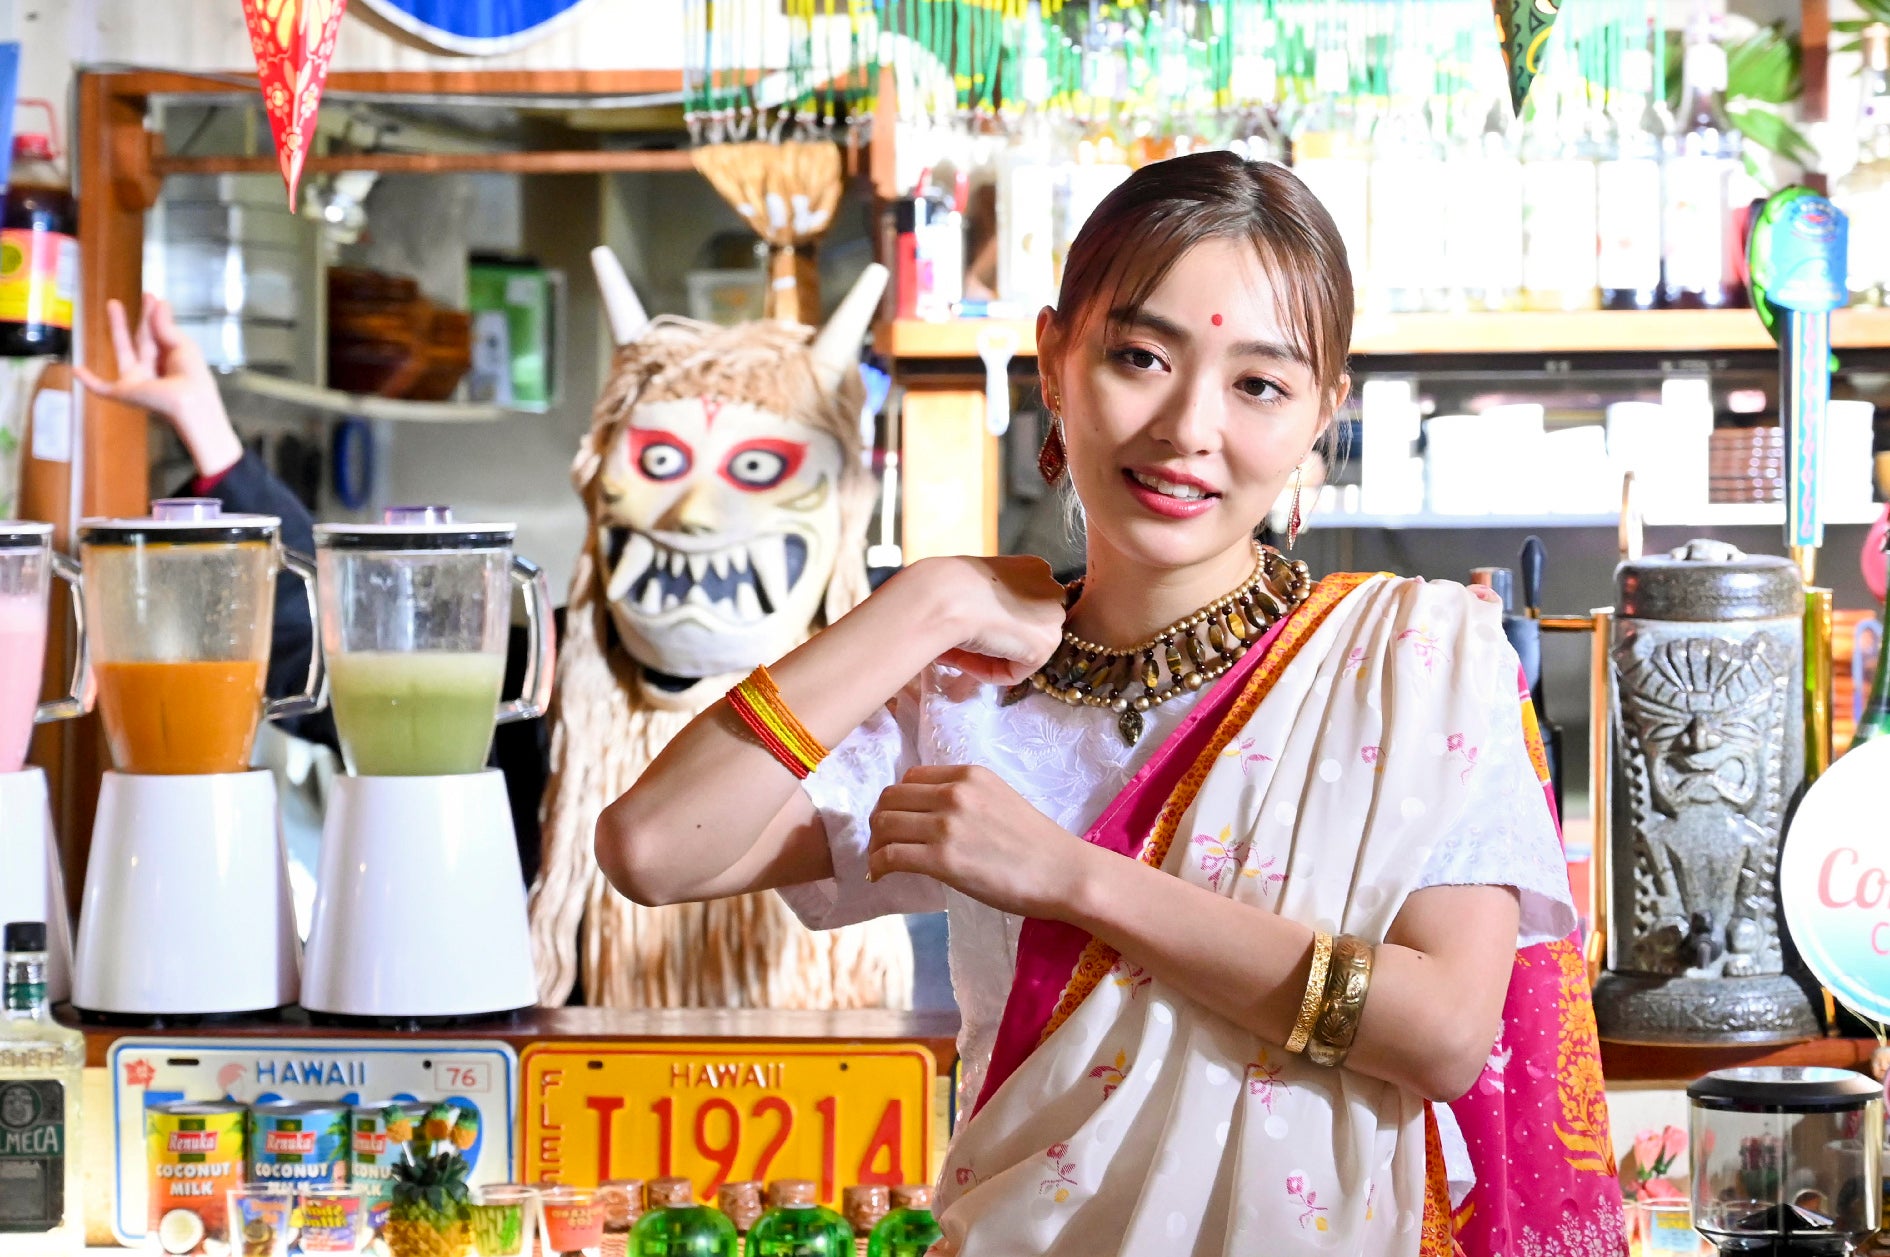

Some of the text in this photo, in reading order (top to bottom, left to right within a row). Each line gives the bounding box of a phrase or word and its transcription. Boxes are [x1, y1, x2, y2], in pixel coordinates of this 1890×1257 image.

[256, 1060, 366, 1086] HAWAII
[446, 1067, 477, 1087] 76
[670, 1062, 785, 1089] HAWAII
[168, 1131, 217, 1151] Renuka
[266, 1131, 313, 1151] Renuka
[585, 1095, 906, 1204] T19214
[155, 1162, 231, 1178] COCONUT
[255, 1161, 329, 1178] COCONUT
[170, 1181, 214, 1196] MILK
